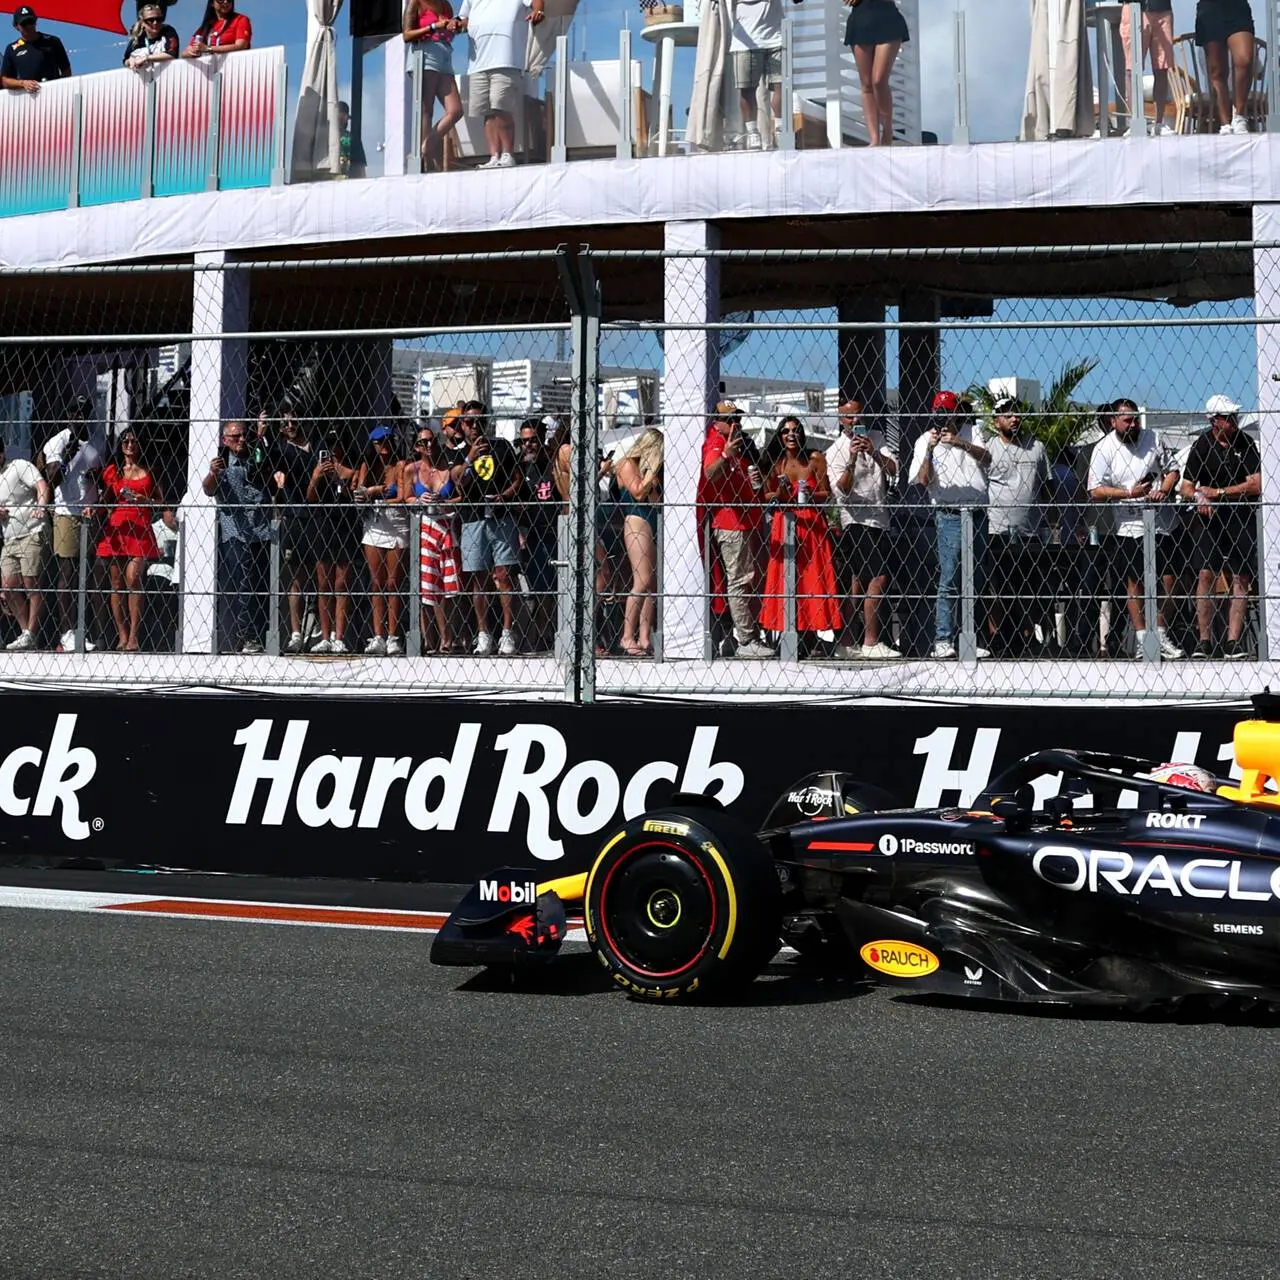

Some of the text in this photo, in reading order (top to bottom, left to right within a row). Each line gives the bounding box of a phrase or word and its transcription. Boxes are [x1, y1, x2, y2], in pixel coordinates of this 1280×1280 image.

[225, 719, 745, 860] Hard Rock
[810, 793, 832, 807] Rock
[1145, 813, 1207, 829] ROKT
[479, 880, 536, 903] Mobil
[1213, 923, 1264, 935] SIEMENS
[881, 949, 929, 968] RAUCH
